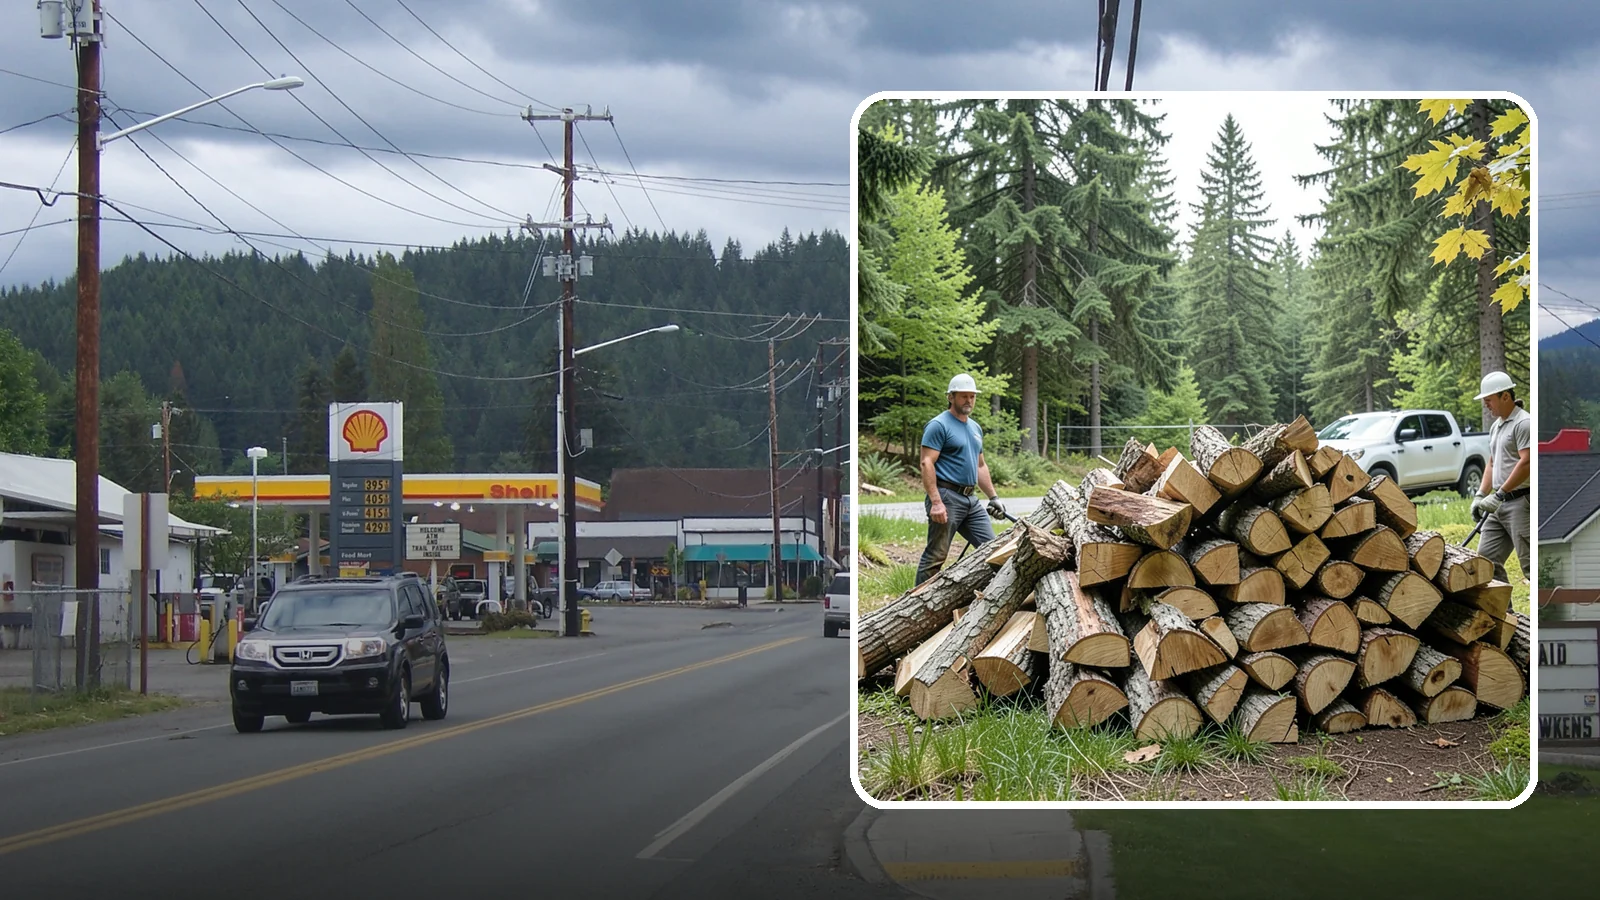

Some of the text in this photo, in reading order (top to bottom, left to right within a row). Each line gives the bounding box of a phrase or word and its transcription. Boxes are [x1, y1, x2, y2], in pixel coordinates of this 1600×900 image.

[366, 480, 383, 490] 395
[490, 484, 547, 499] Shell
[366, 494, 383, 504] 405
[366, 508, 383, 518] 415
[366, 522, 383, 532] 429
